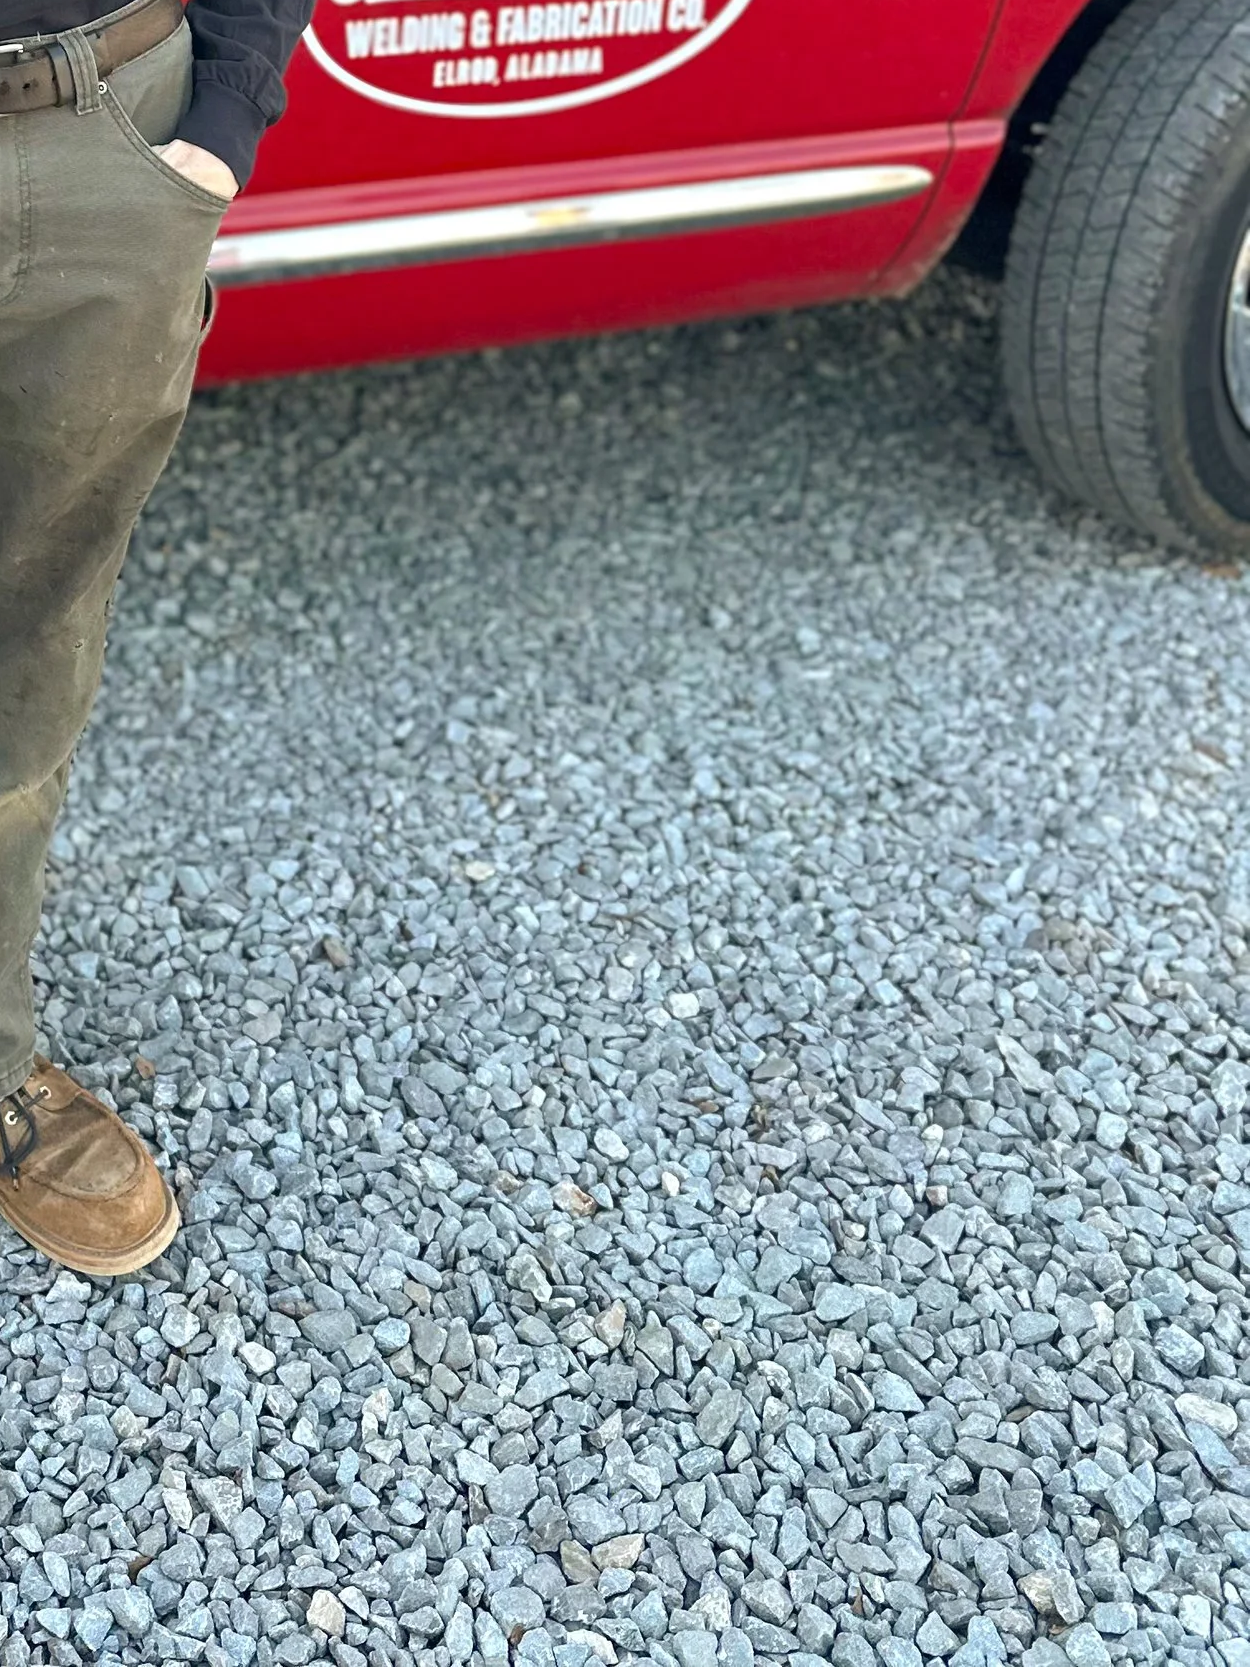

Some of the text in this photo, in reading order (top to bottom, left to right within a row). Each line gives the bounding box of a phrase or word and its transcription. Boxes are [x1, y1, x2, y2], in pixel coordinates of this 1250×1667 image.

[345, 10, 466, 59] WELDING
[469, 10, 491, 49] &
[432, 47, 604, 88] ELROD, ALABAMA
